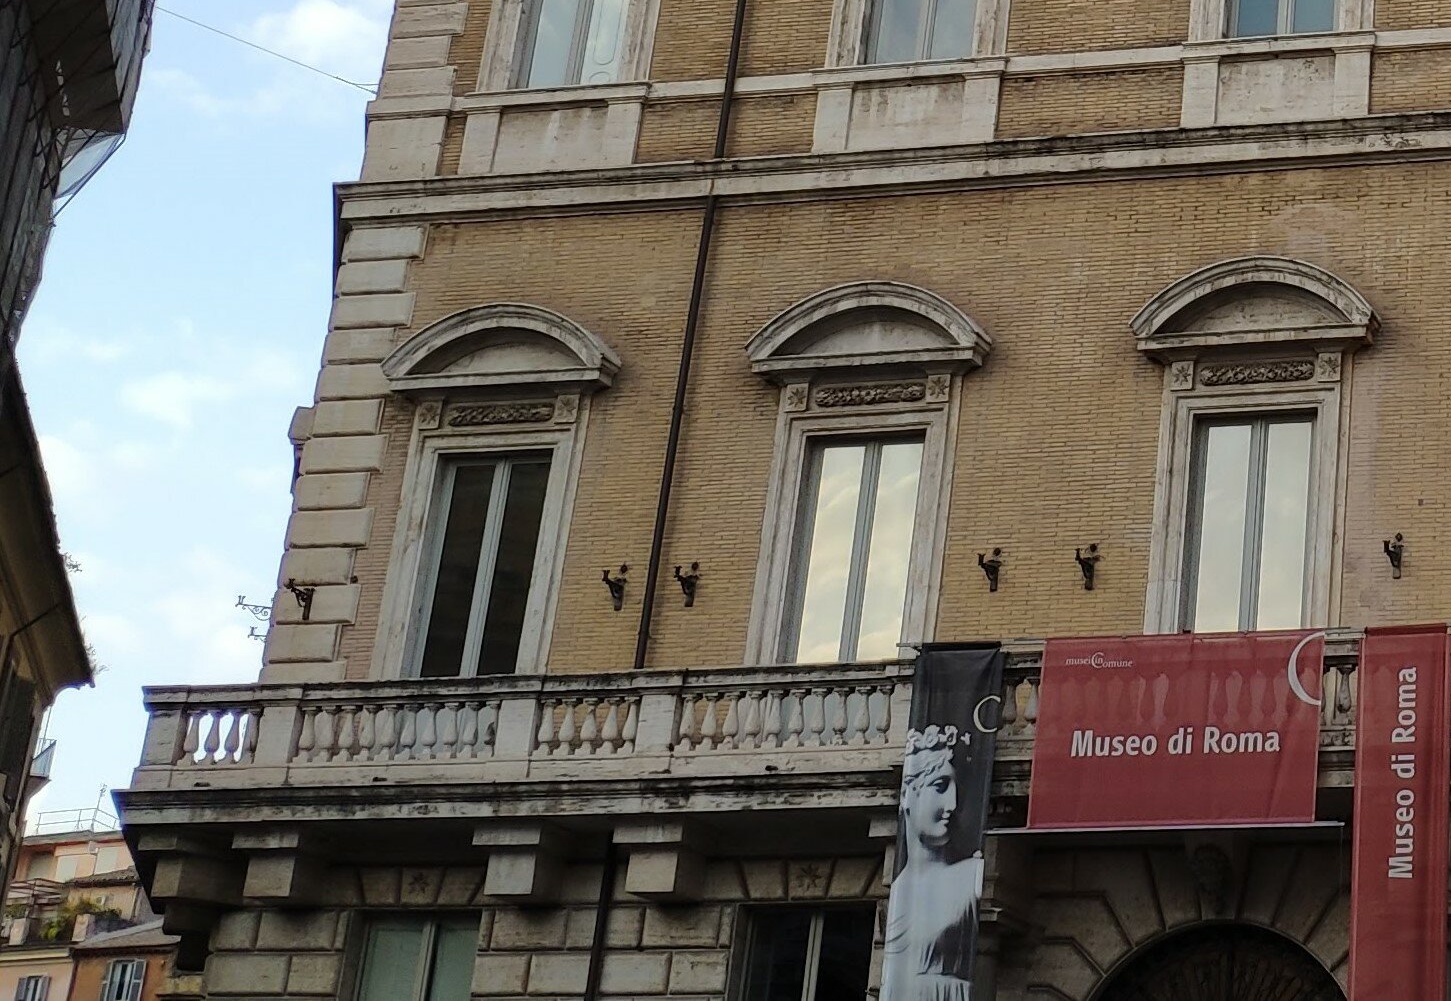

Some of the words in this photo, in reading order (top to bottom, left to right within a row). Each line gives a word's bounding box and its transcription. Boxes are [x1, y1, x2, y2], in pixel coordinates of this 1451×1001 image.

[1391, 666, 1417, 743] Roma
[1070, 729, 1158, 758] Museo
[1167, 727, 1194, 755] di
[1203, 726, 1280, 754] Roma
[1390, 754, 1415, 779] di
[1388, 789, 1415, 879] Museo
